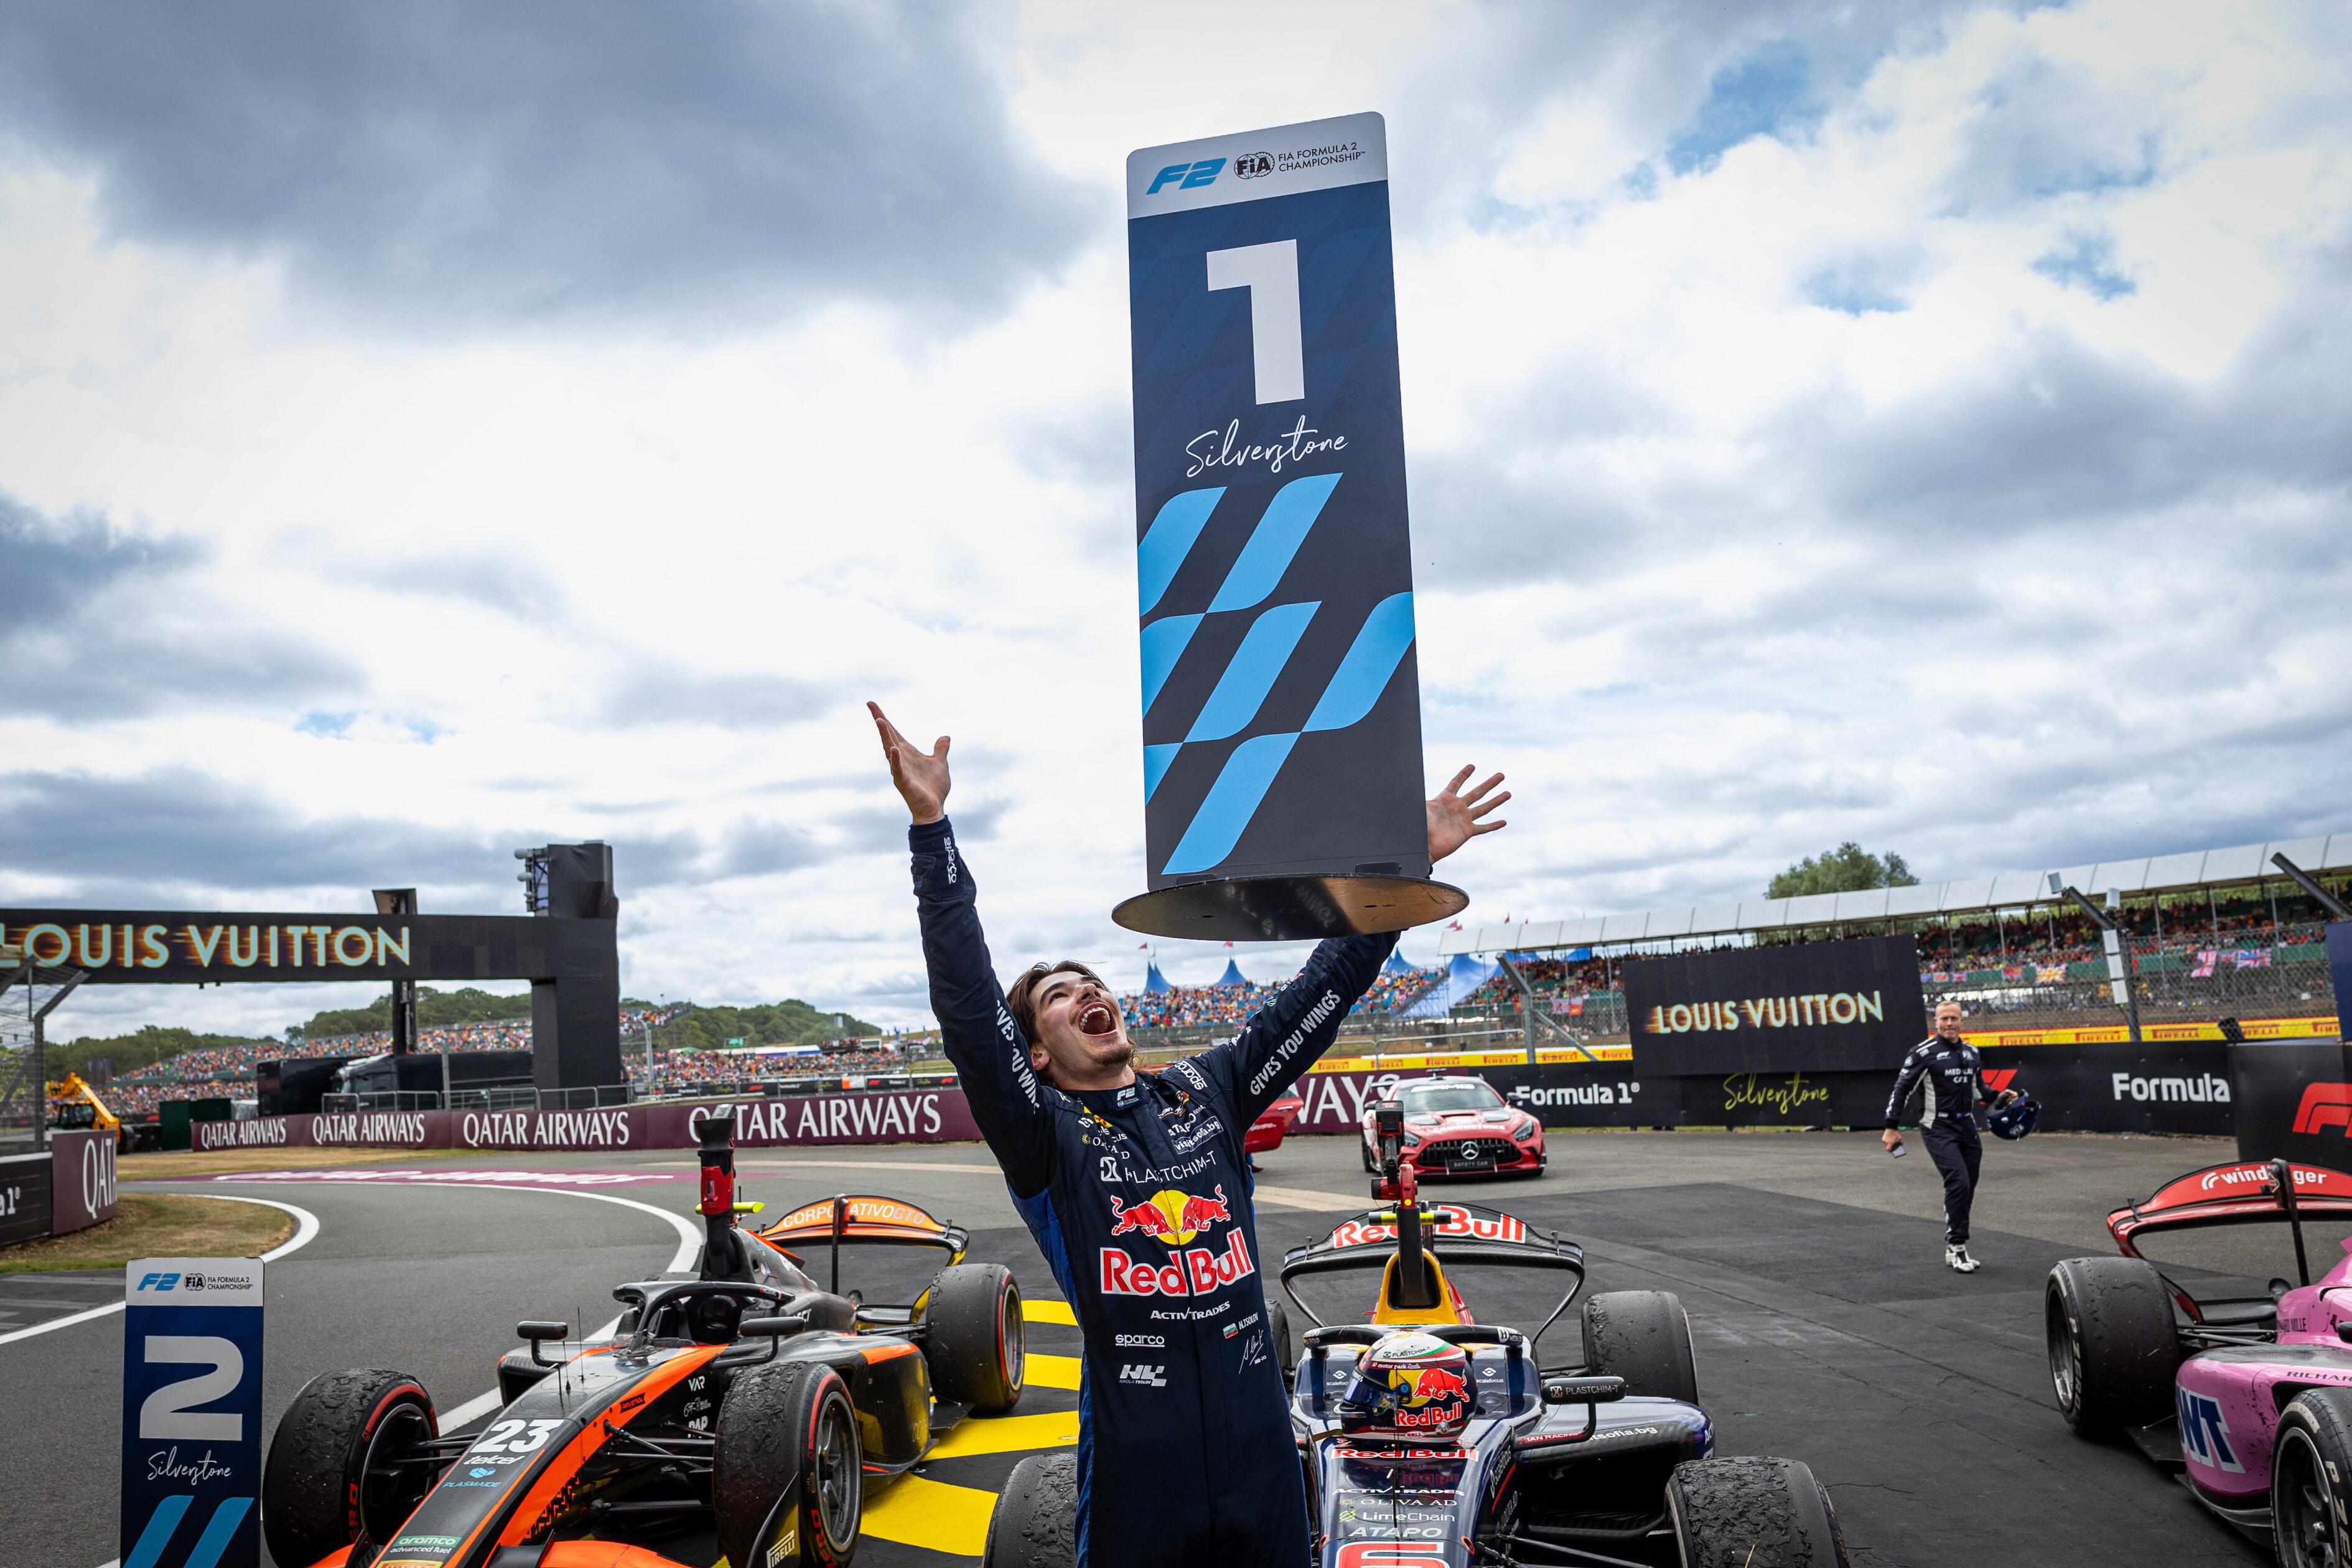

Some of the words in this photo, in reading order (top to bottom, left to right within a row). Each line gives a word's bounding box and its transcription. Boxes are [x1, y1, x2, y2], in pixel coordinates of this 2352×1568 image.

[1278, 152, 1294, 162] FIA
[1297, 144, 1348, 159] FORMULA
[1351, 142, 1357, 151] 2
[1146, 157, 1227, 195] F2
[1206, 238, 1305, 405] 1
[1185, 415, 1348, 478] Silverstone
[0, 923, 170, 968] LOUIS
[187, 925, 411, 968] VUITTON
[1656, 1000, 1740, 1034] LOUIS
[1745, 991, 1883, 1029] VUITTON
[1250, 1056, 1282, 1095] GIVES
[1276, 1029, 1304, 1061] YOU
[1300, 989, 1341, 1034] WINGS
[1999, 1034, 2043, 1046] PIRELLI
[2074, 1030, 2121, 1042] PIRELLI
[2152, 1027, 2200, 1038] PIRELLI
[1371, 1060, 1404, 1068] PRELLI
[1426, 1057, 1460, 1066] PIRELLI
[1483, 1055, 1518, 1063] PIRELLI
[1542, 1052, 1578, 1062] PIRELLI
[1944, 1068, 1973, 1076] MEDCAL
[1117, 1087, 1135, 1101] F2
[1515, 1083, 1614, 1106] Formula
[1723, 1071, 1829, 1114] Silverstone
[2112, 1073, 2231, 1103] Formula
[312, 1113, 358, 1144] QATAR
[360, 1113, 425, 1142] AIRWAYS
[462, 1112, 529, 1147] QATAR
[533, 1111, 630, 1146] AIRWAYS
[688, 1103, 789, 1143] QTAR
[796, 1094, 942, 1139] AIRWAYS
[200, 1122, 236, 1150] QATAR
[238, 1117, 287, 1147] AIRWAYS
[83, 1137, 117, 1220] QAT
[2220, 1165, 2327, 1185] windger
[1333, 1220, 1406, 1249] Re
[1435, 1205, 1526, 1244] Bull
[1100, 1247, 1189, 1297] Red
[1186, 1226, 1255, 1296] Bull
[137, 1273, 181, 1291] F2
[1115, 1334, 1165, 1347] sparco
[1393, 1346, 1431, 1357] PLASTCHIM-T
[2073, 1339, 2083, 1410] ZERO
[139, 1335, 243, 1441] 2
[1566, 1384, 1618, 1394] PLASTCHIM-T
[1395, 1407, 1430, 1427] Red
[1431, 1401, 1462, 1426] Bull
[470, 1419, 564, 1453] 23
[147, 1446, 232, 1485] Silverstone
[463, 1455, 525, 1465] telcel
[1333, 1449, 1404, 1458] Red
[1405, 1449, 1478, 1462] Bull
[2325, 1461, 2340, 1483] P
[348, 1483, 359, 1544] ERO
[1363, 1512, 1455, 1522] LimeChain
[398, 1537, 456, 1546] aramco
[1348, 1527, 1443, 1538] ATAPO
[767, 1530, 795, 1568] PIRELLI
